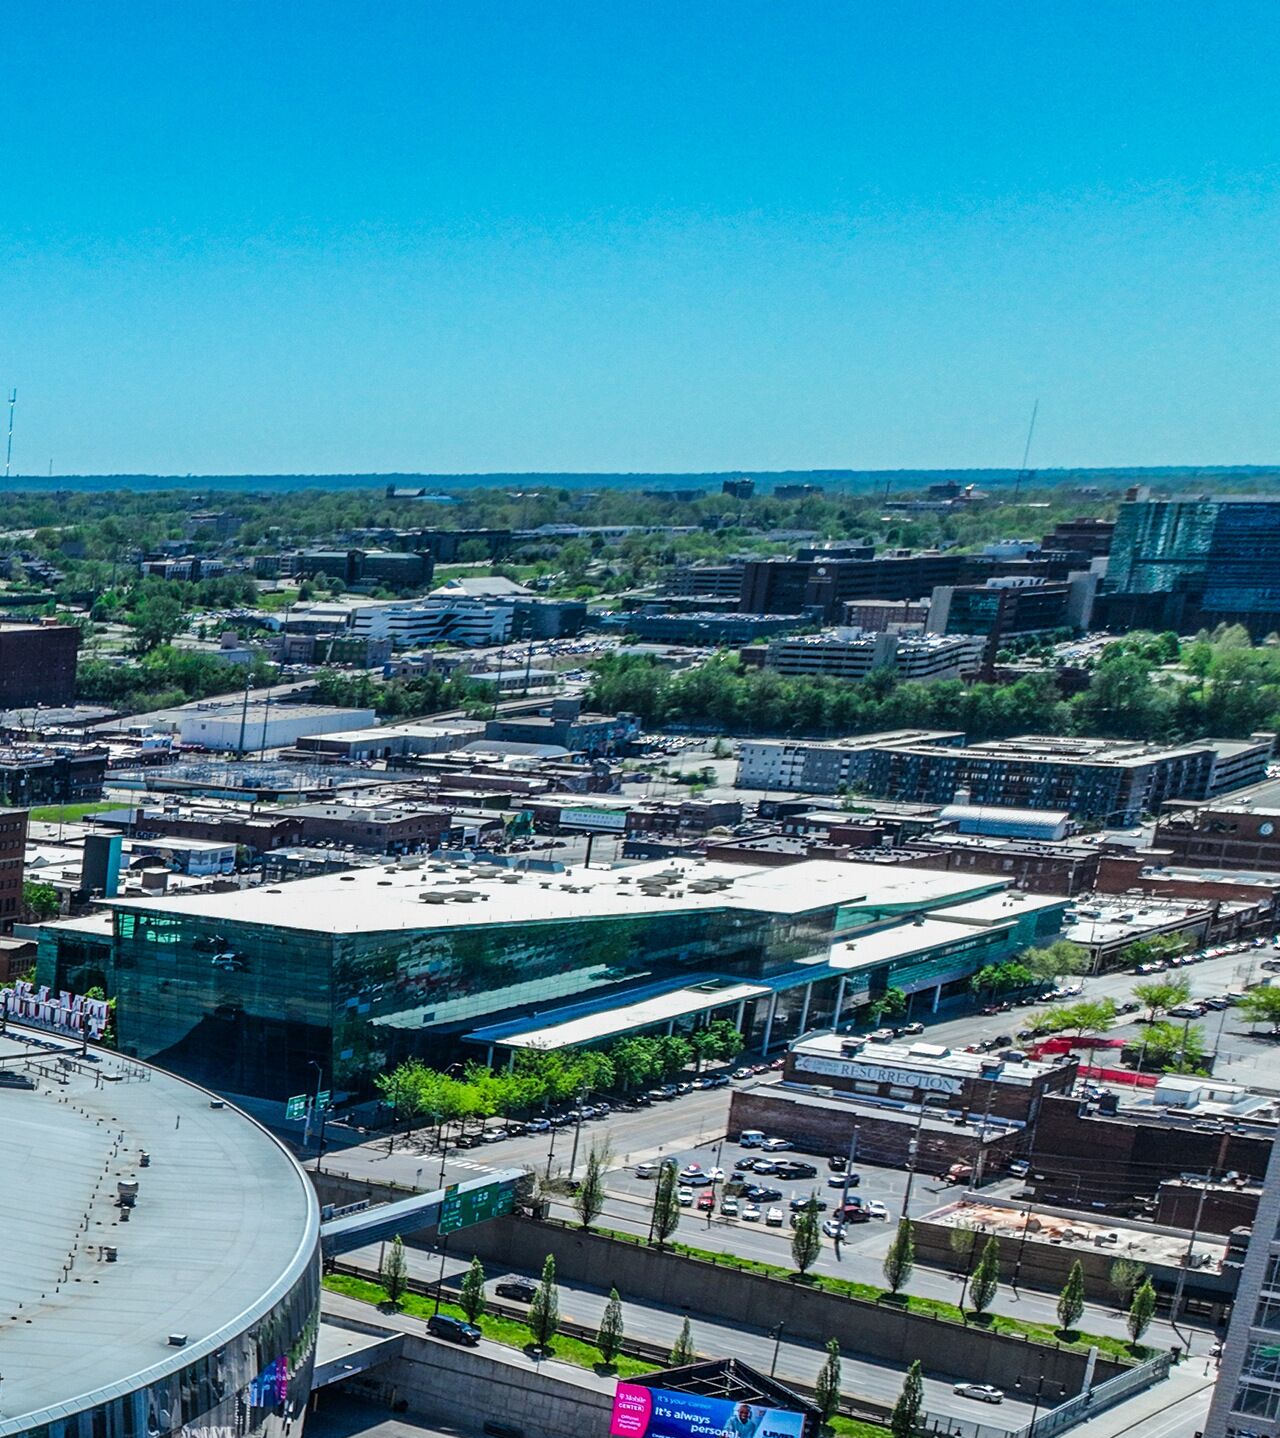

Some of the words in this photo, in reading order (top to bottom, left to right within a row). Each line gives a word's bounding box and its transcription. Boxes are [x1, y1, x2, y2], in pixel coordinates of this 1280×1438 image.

[841, 1064, 954, 1091] RESURRECTION
[626, 1394, 646, 1403] Mobile
[657, 1395, 669, 1403] It's
[670, 1397, 687, 1405] your
[618, 1402, 645, 1412] CENTER
[655, 1406, 672, 1418] It's
[673, 1410, 711, 1424] always
